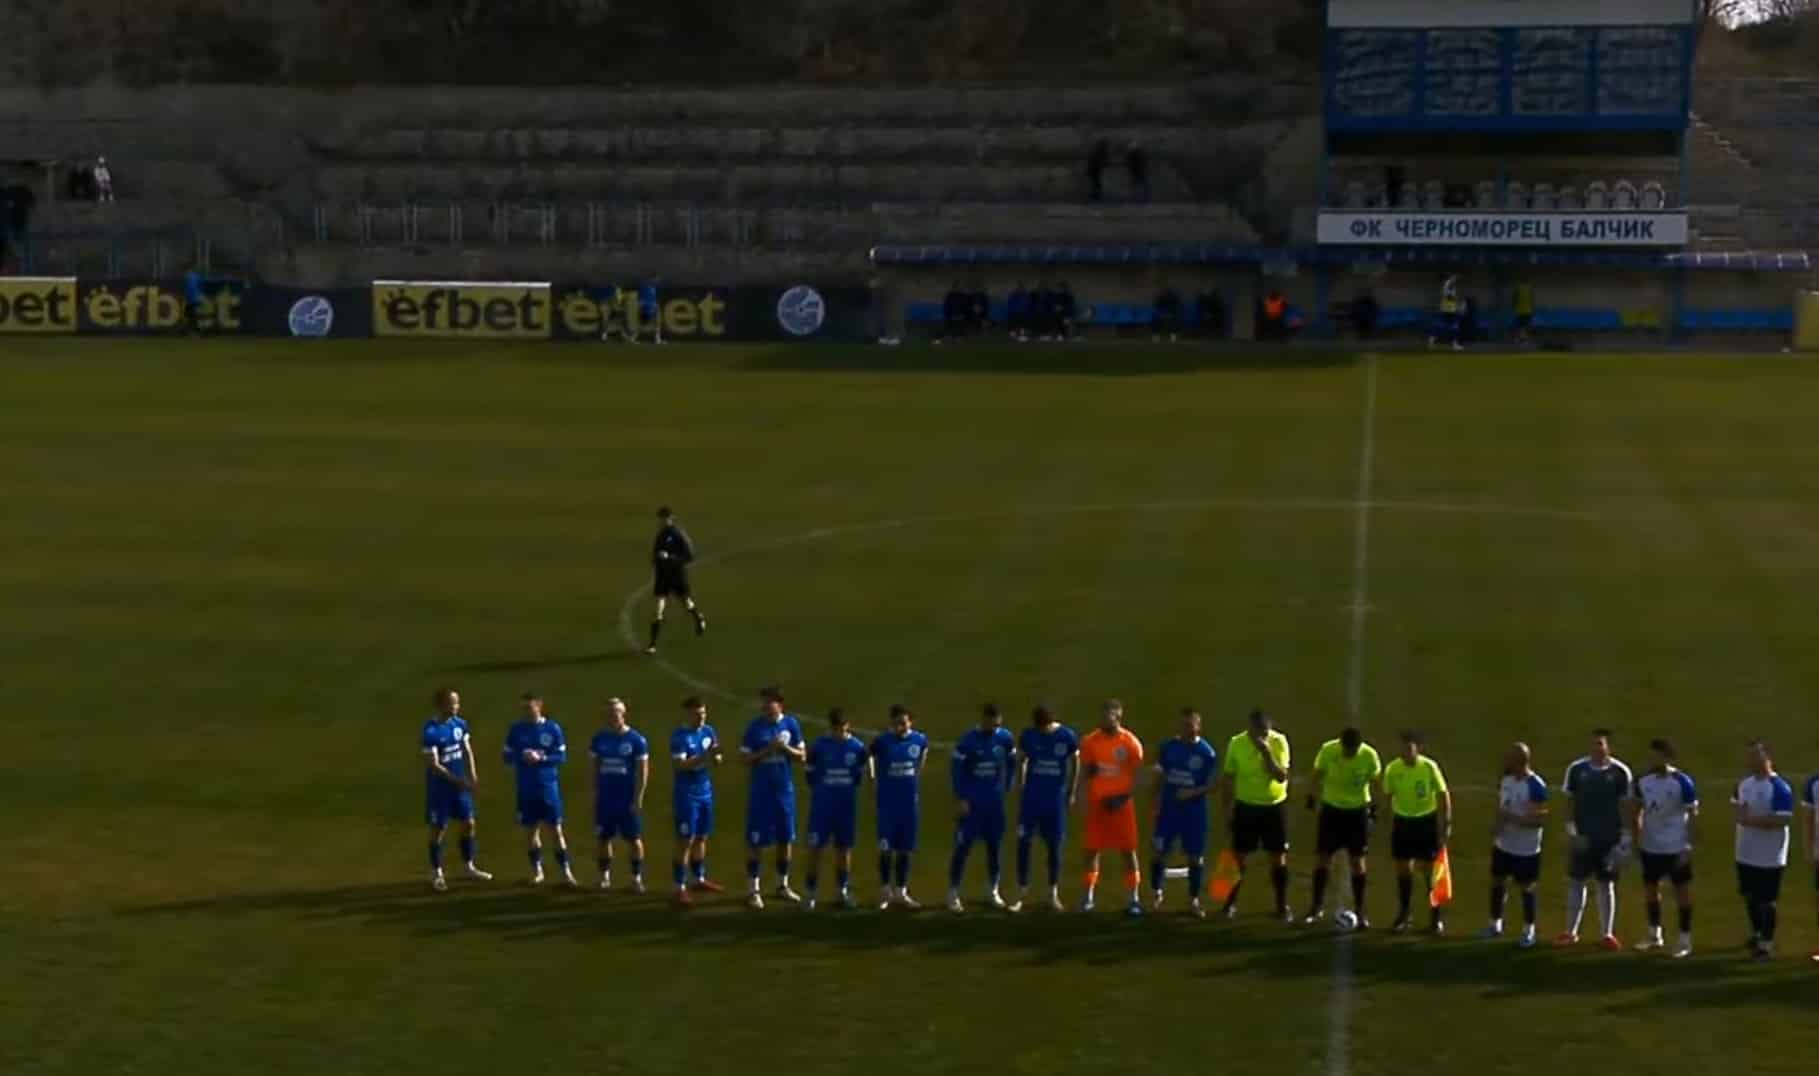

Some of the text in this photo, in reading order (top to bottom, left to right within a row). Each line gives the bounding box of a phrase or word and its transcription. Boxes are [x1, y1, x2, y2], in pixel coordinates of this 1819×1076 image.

[1349, 219, 1655, 240] ФК ЧЕРНОМОРЕЦ БАЛЧИК
[382, 289, 544, 330] efbet
